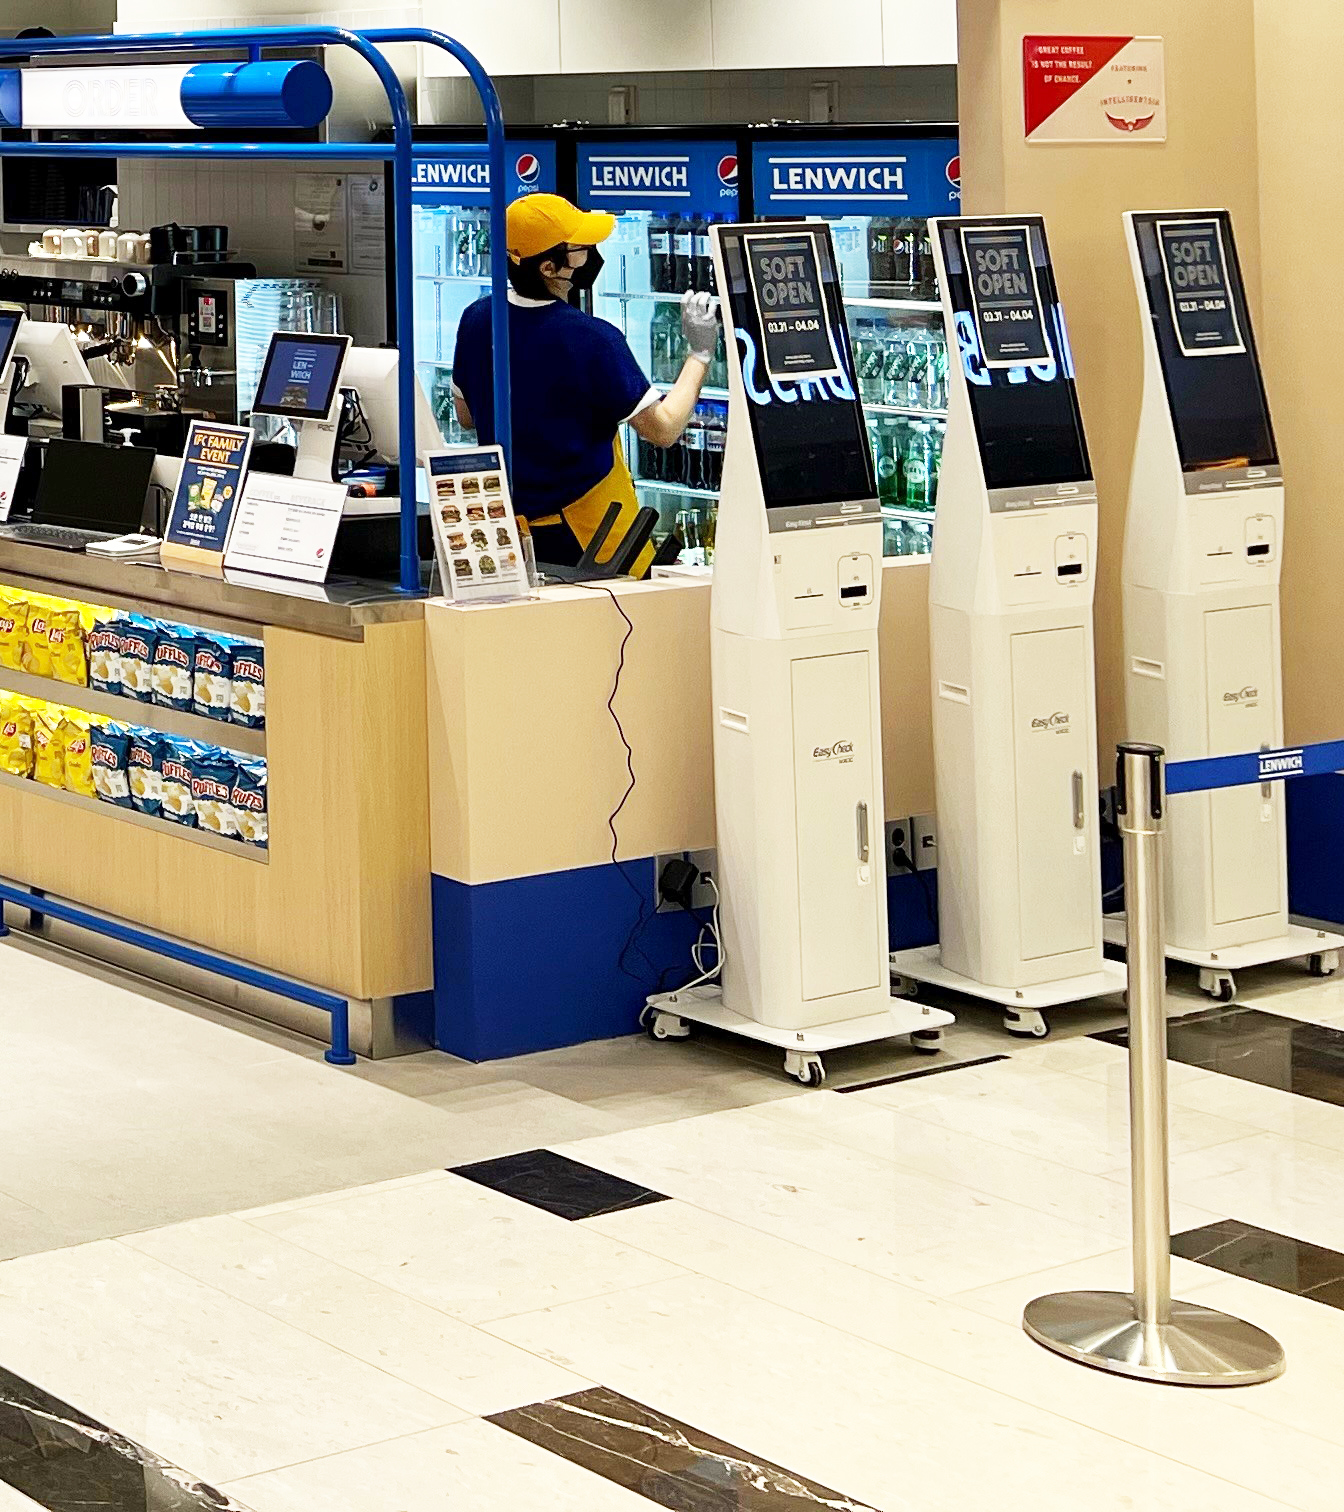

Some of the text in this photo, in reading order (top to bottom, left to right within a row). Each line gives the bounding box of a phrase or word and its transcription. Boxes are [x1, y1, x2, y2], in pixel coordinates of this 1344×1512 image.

[1035, 46, 1084, 55] GREAT COFFEE
[1040, 61, 1054, 69] NOT
[1068, 61, 1092, 69] RESULT
[62, 78, 159, 118] ORDER
[592, 165, 687, 187] LENWICH
[773, 167, 904, 190] LENWICH
[719, 188, 738, 198] pep
[975, 248, 1019, 272] SOFT
[1170, 241, 1211, 263] SOFT
[760, 255, 805, 281] SOFT
[1174, 264, 1221, 287] OPEN
[762, 280, 814, 307] OPEN
[978, 272, 1028, 296] OPEN
[207, 435, 244, 452] FAMILY
[200, 448, 231, 463] EVENT
[156, 644, 190, 668] UFFLES
[233, 660, 264, 682] UFFLES
[1259, 755, 1303, 774] LENWICH
[192, 777, 230, 801] RUFFLES
